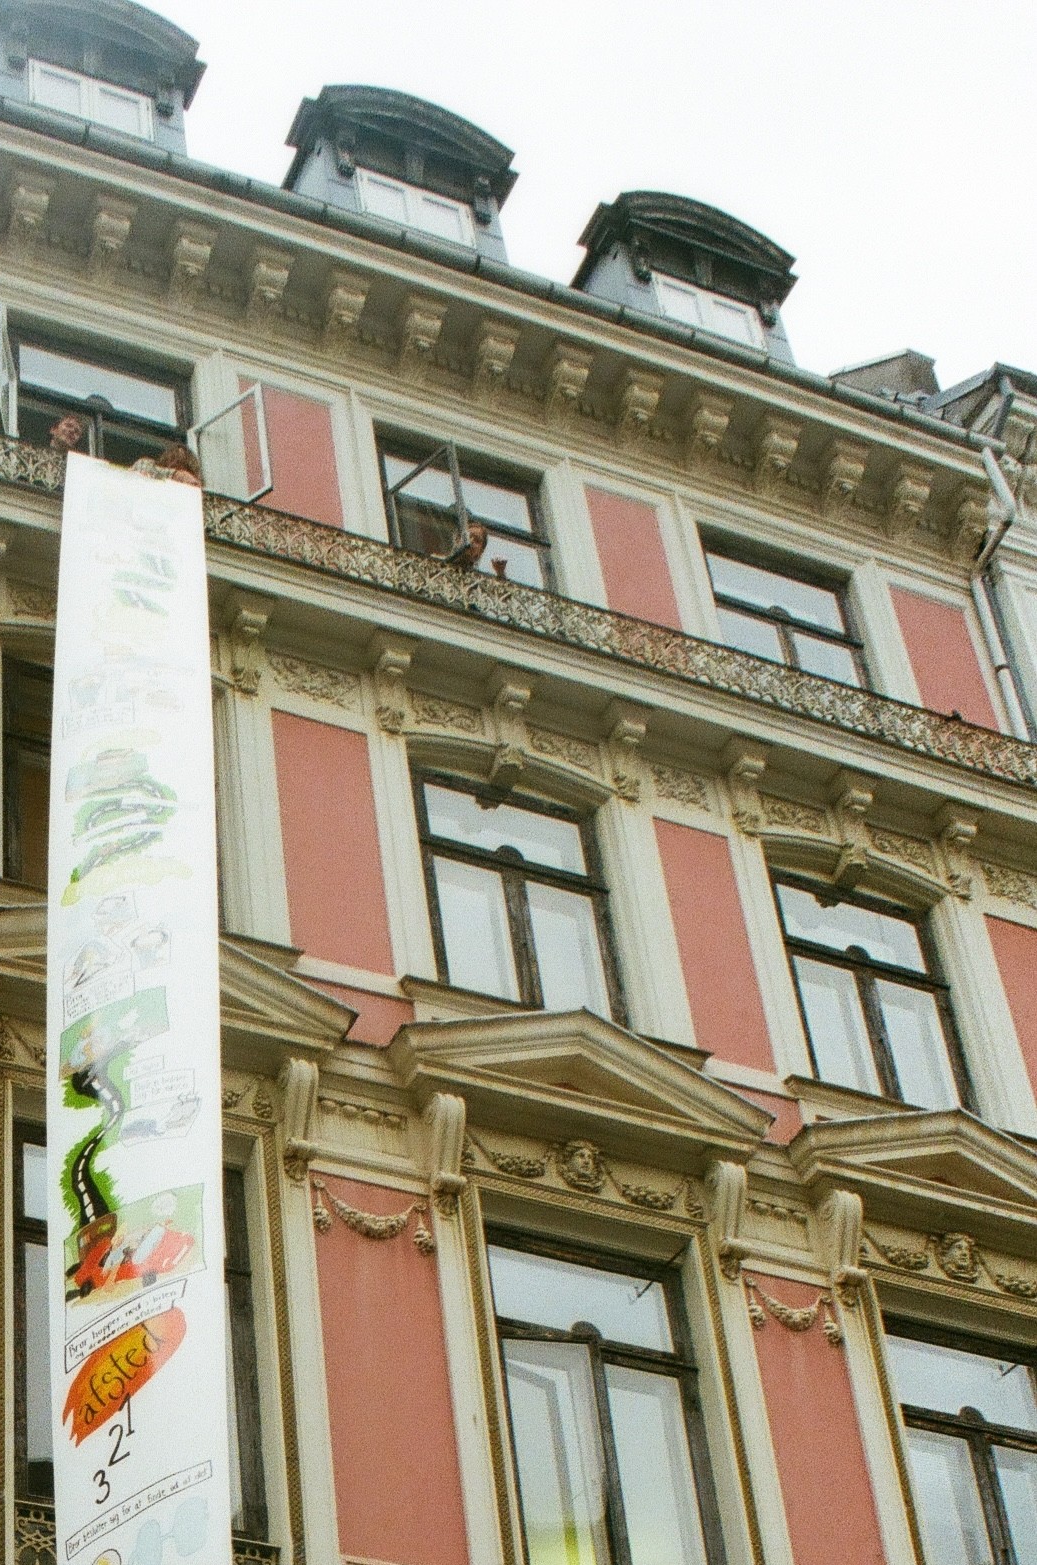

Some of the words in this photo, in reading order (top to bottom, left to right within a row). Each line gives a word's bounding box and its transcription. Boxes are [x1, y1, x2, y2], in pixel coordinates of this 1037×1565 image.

[92, 1316, 120, 1339] hopper
[79, 1321, 162, 1425] afsted
[119, 1392, 135, 1437] 1
[108, 1423, 131, 1467] 2
[93, 1469, 111, 1505] 3
[82, 1520, 107, 1542] beslutter
